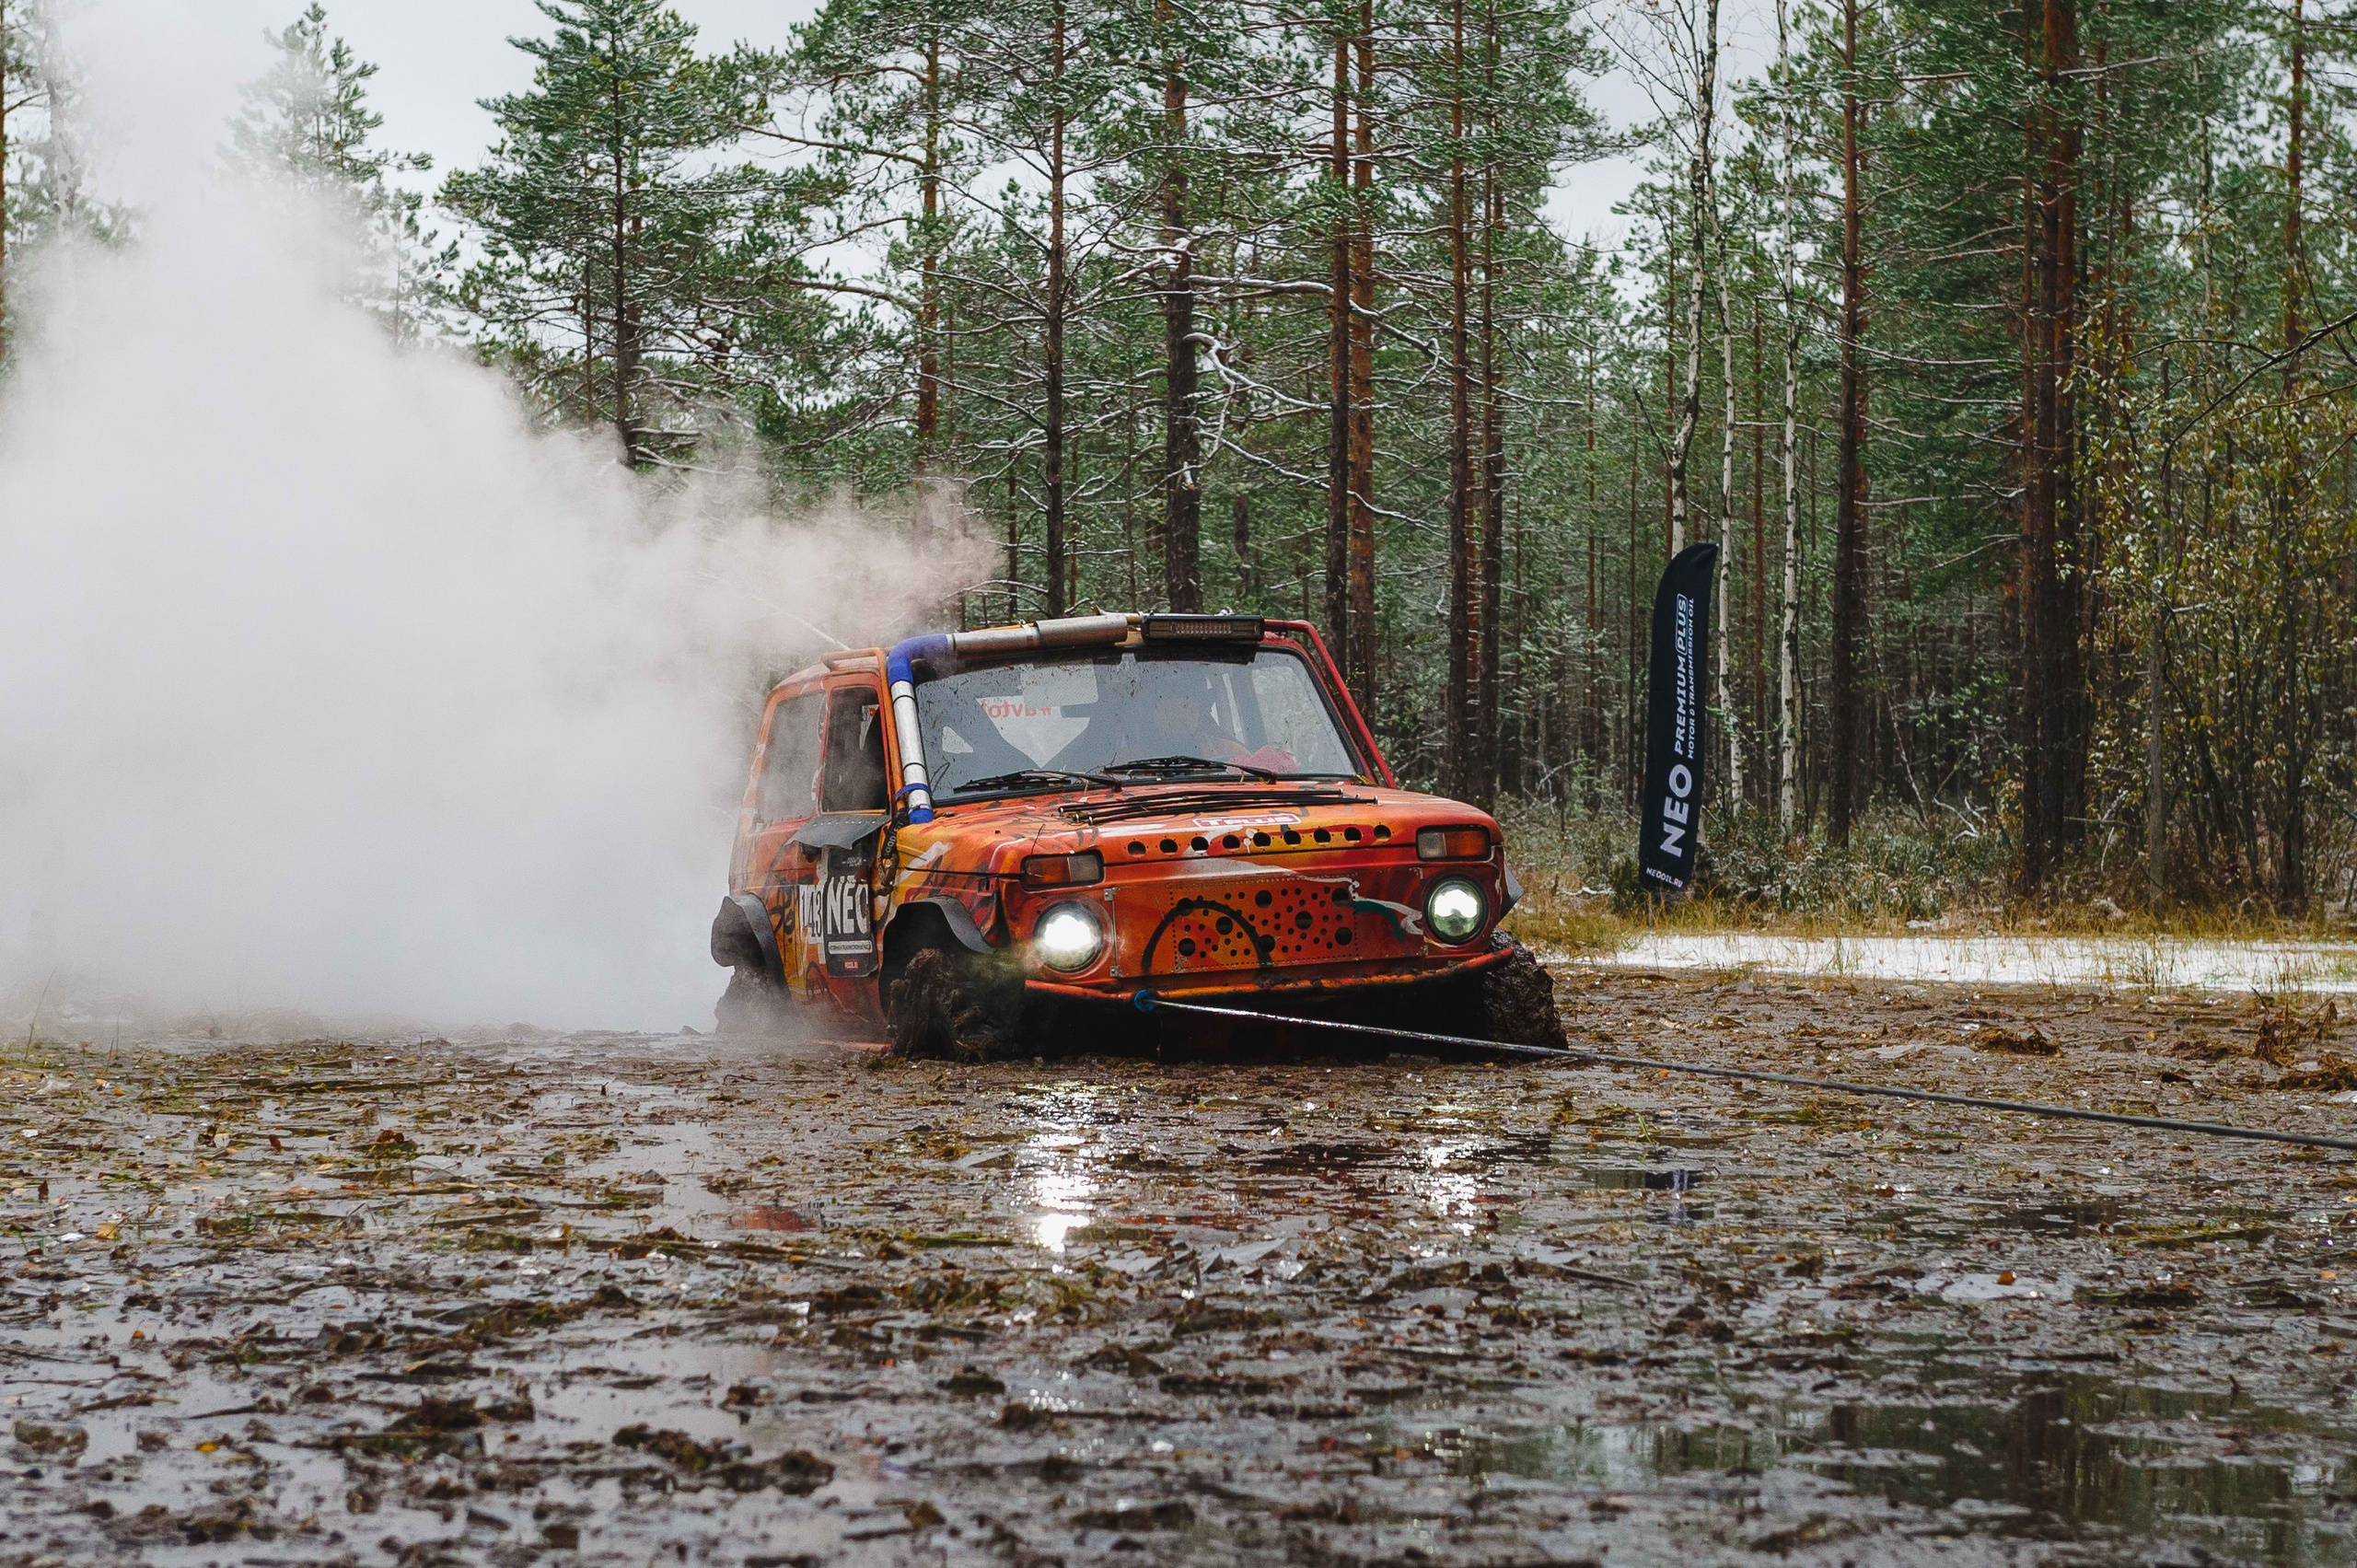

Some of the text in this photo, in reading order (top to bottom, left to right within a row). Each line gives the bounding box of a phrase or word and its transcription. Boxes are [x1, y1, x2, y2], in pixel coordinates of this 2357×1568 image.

[1660, 598, 1692, 857] NEO PREMIUM PLUS
[1687, 718, 1695, 760] MOTOR
[1645, 866, 1684, 889] NEOOIL.RU
[801, 889, 822, 937] 143
